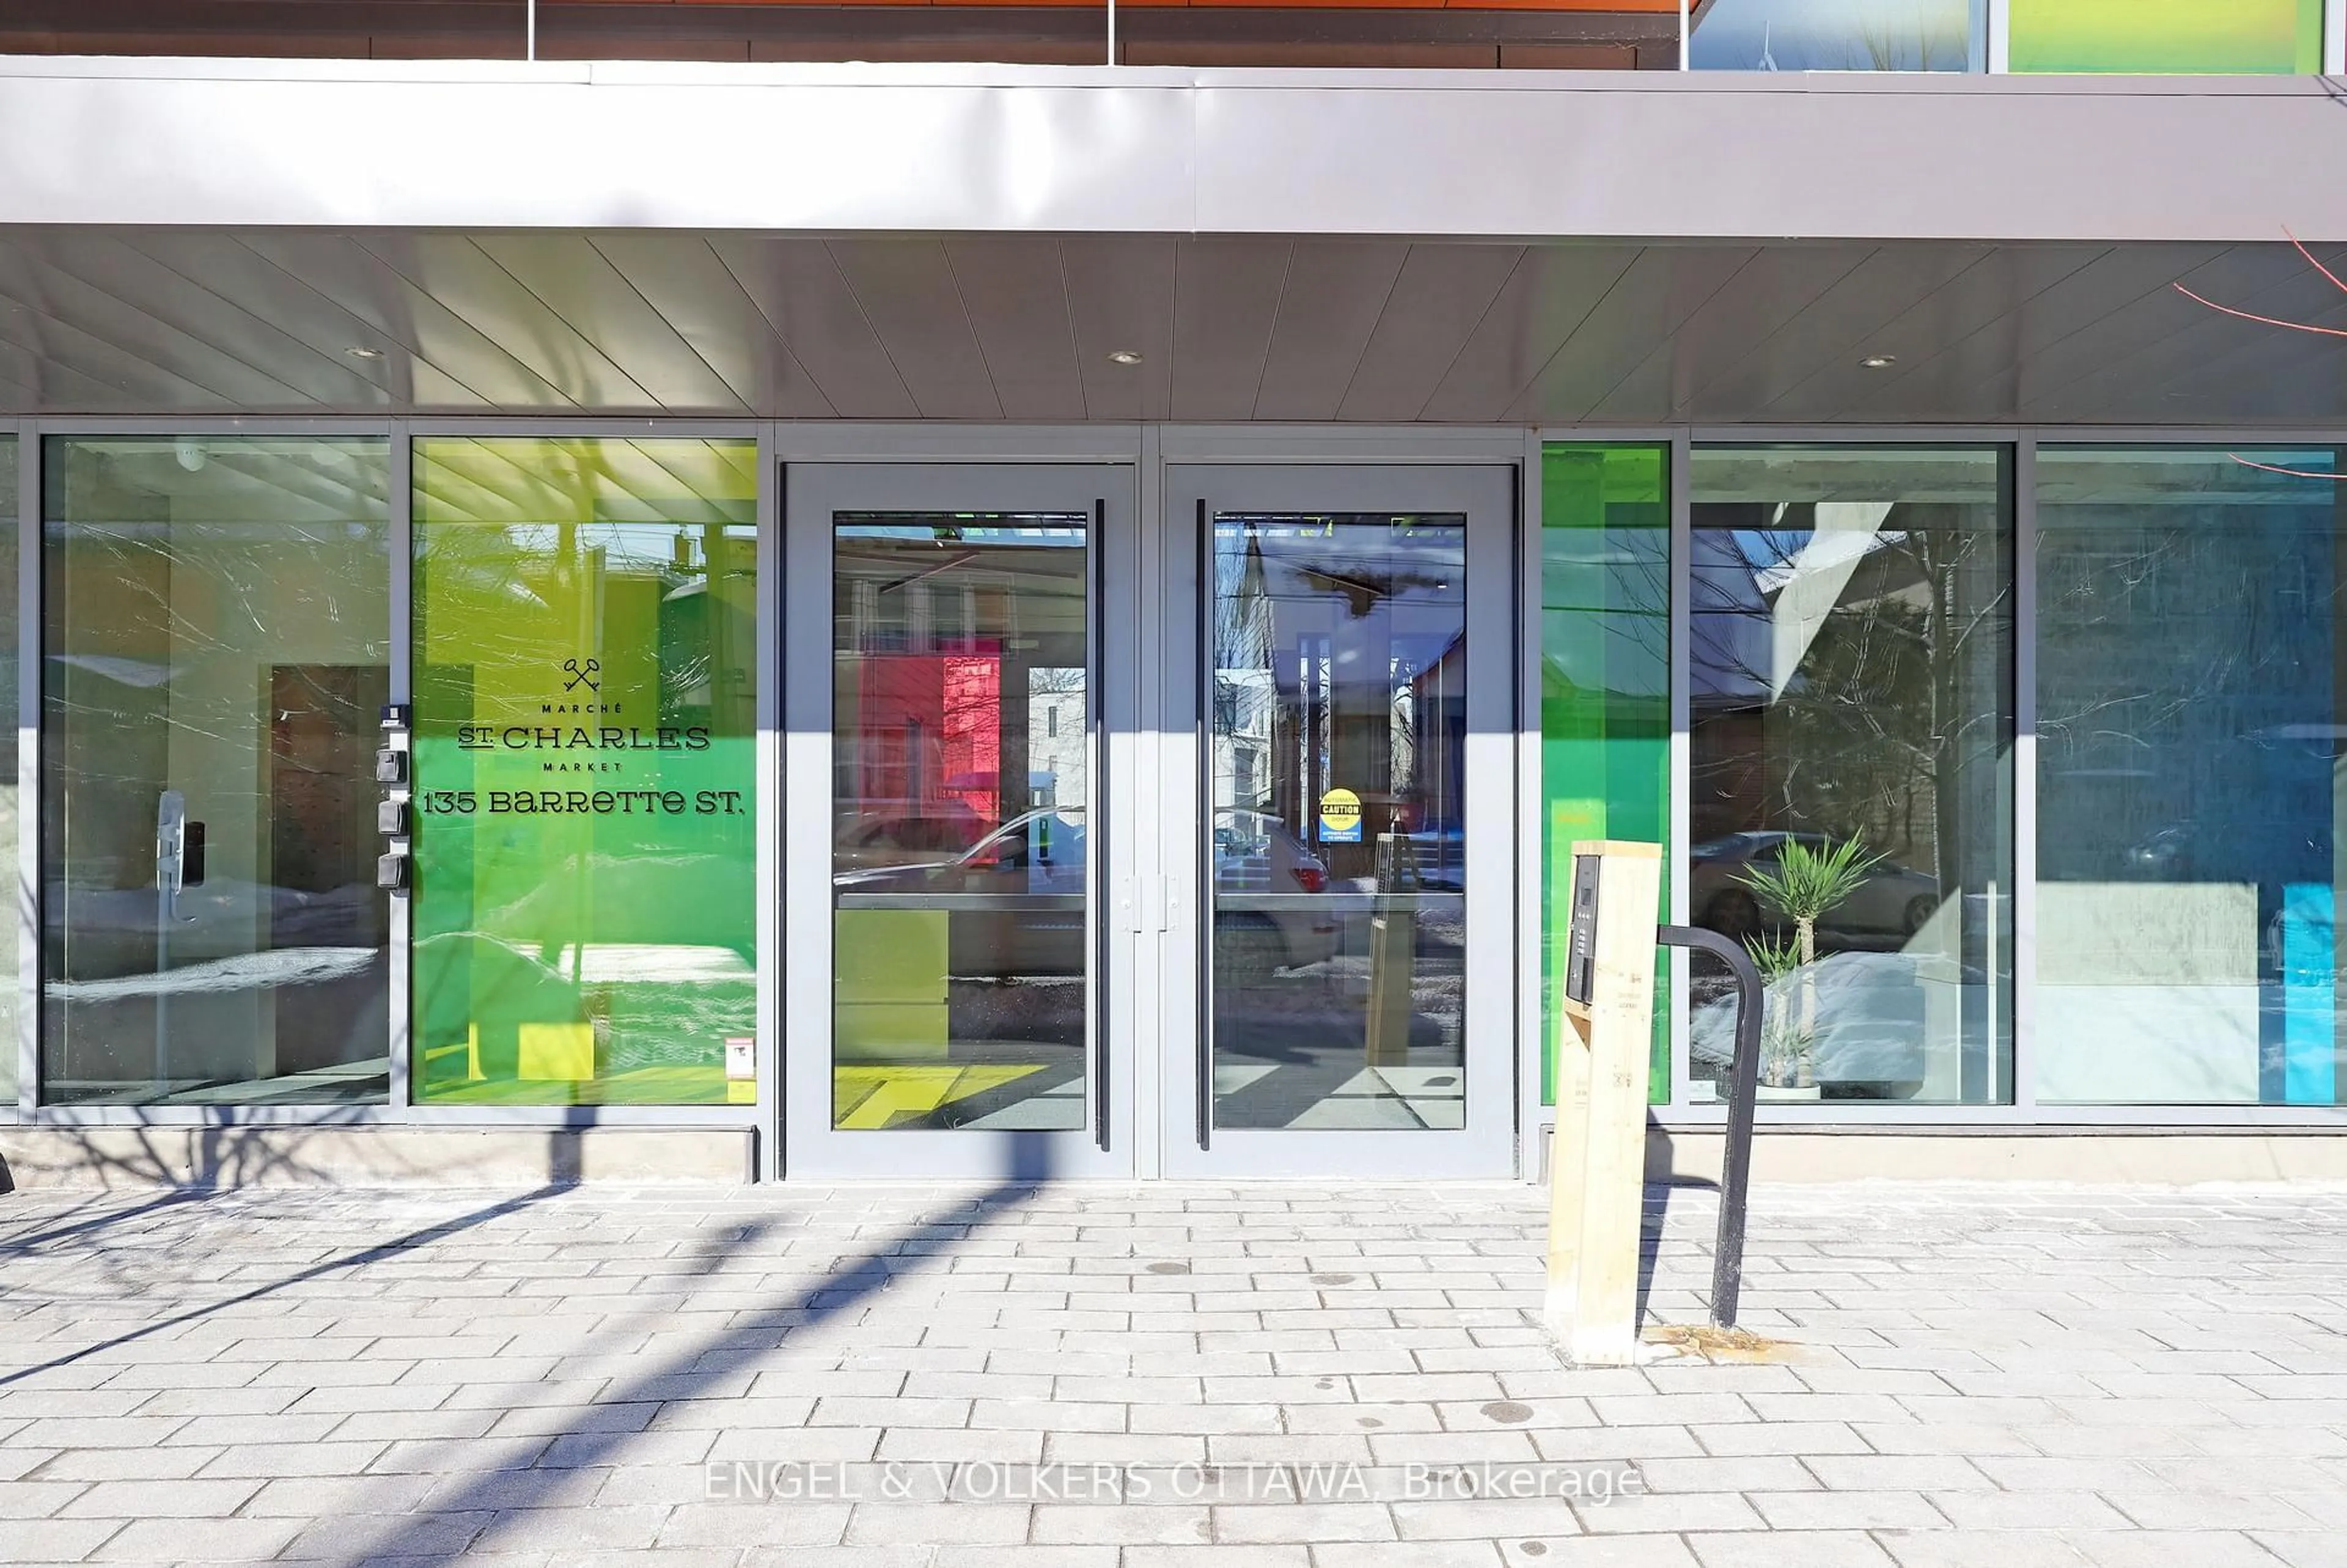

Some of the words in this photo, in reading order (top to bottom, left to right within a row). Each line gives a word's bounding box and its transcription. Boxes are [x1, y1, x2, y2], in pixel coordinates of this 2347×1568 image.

[542, 702, 622, 714] MARCHÉ
[458, 727, 494, 744] ST.
[502, 727, 711, 749] CHARLES
[543, 763, 622, 772] MARKET
[424, 791, 476, 813] 135
[695, 791, 745, 814] ST.
[1323, 805, 1359, 814] CAUTION
